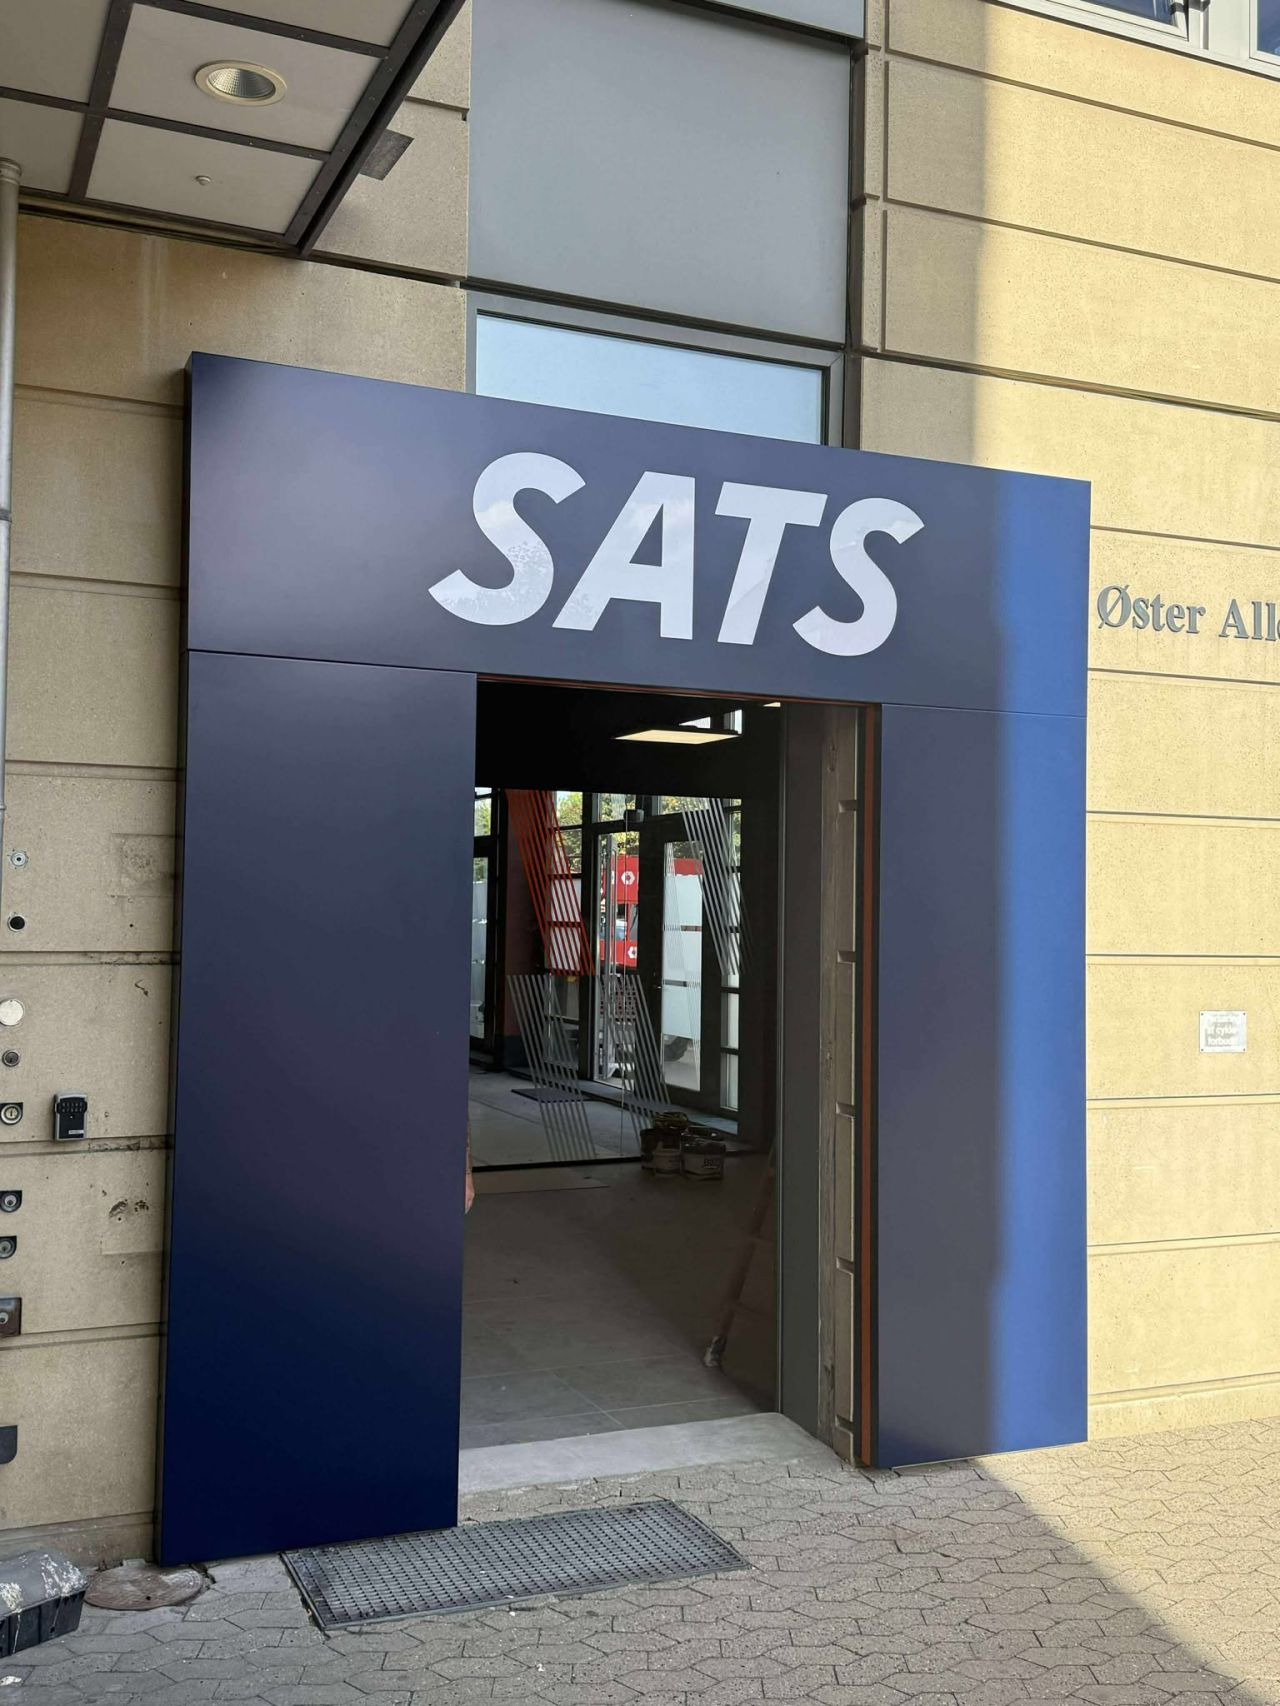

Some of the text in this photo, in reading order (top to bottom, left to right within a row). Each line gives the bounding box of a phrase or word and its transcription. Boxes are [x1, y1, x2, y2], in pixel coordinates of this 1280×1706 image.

[428, 452, 925, 657] SATS
[1097, 585, 1280, 642] Øster All
